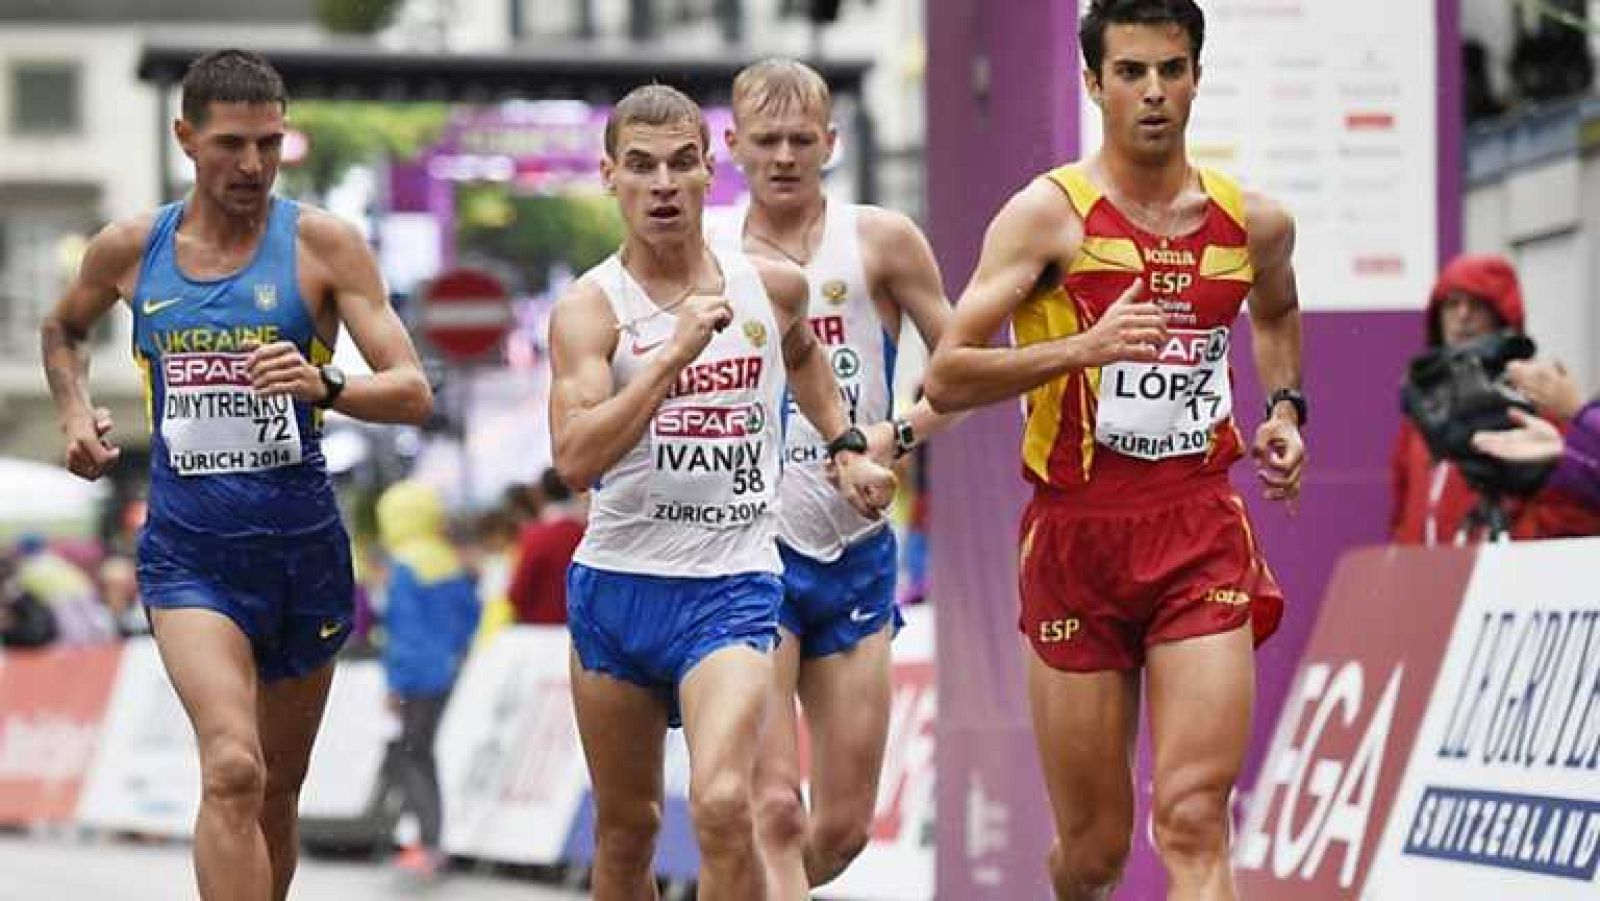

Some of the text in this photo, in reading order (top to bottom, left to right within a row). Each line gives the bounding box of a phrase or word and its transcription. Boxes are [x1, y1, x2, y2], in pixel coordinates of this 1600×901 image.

[1150, 272, 1193, 293] ESP
[167, 358, 251, 382] SPAR
[667, 357, 763, 398] USSIA
[1116, 366, 1214, 400] LÓPZ
[1185, 396, 1221, 420] 17
[253, 416, 291, 442] 72
[657, 410, 748, 434] SPAR
[733, 468, 765, 495] 58
[1039, 617, 1080, 643] ESP
[1482, 610, 1600, 769] GRUYE
